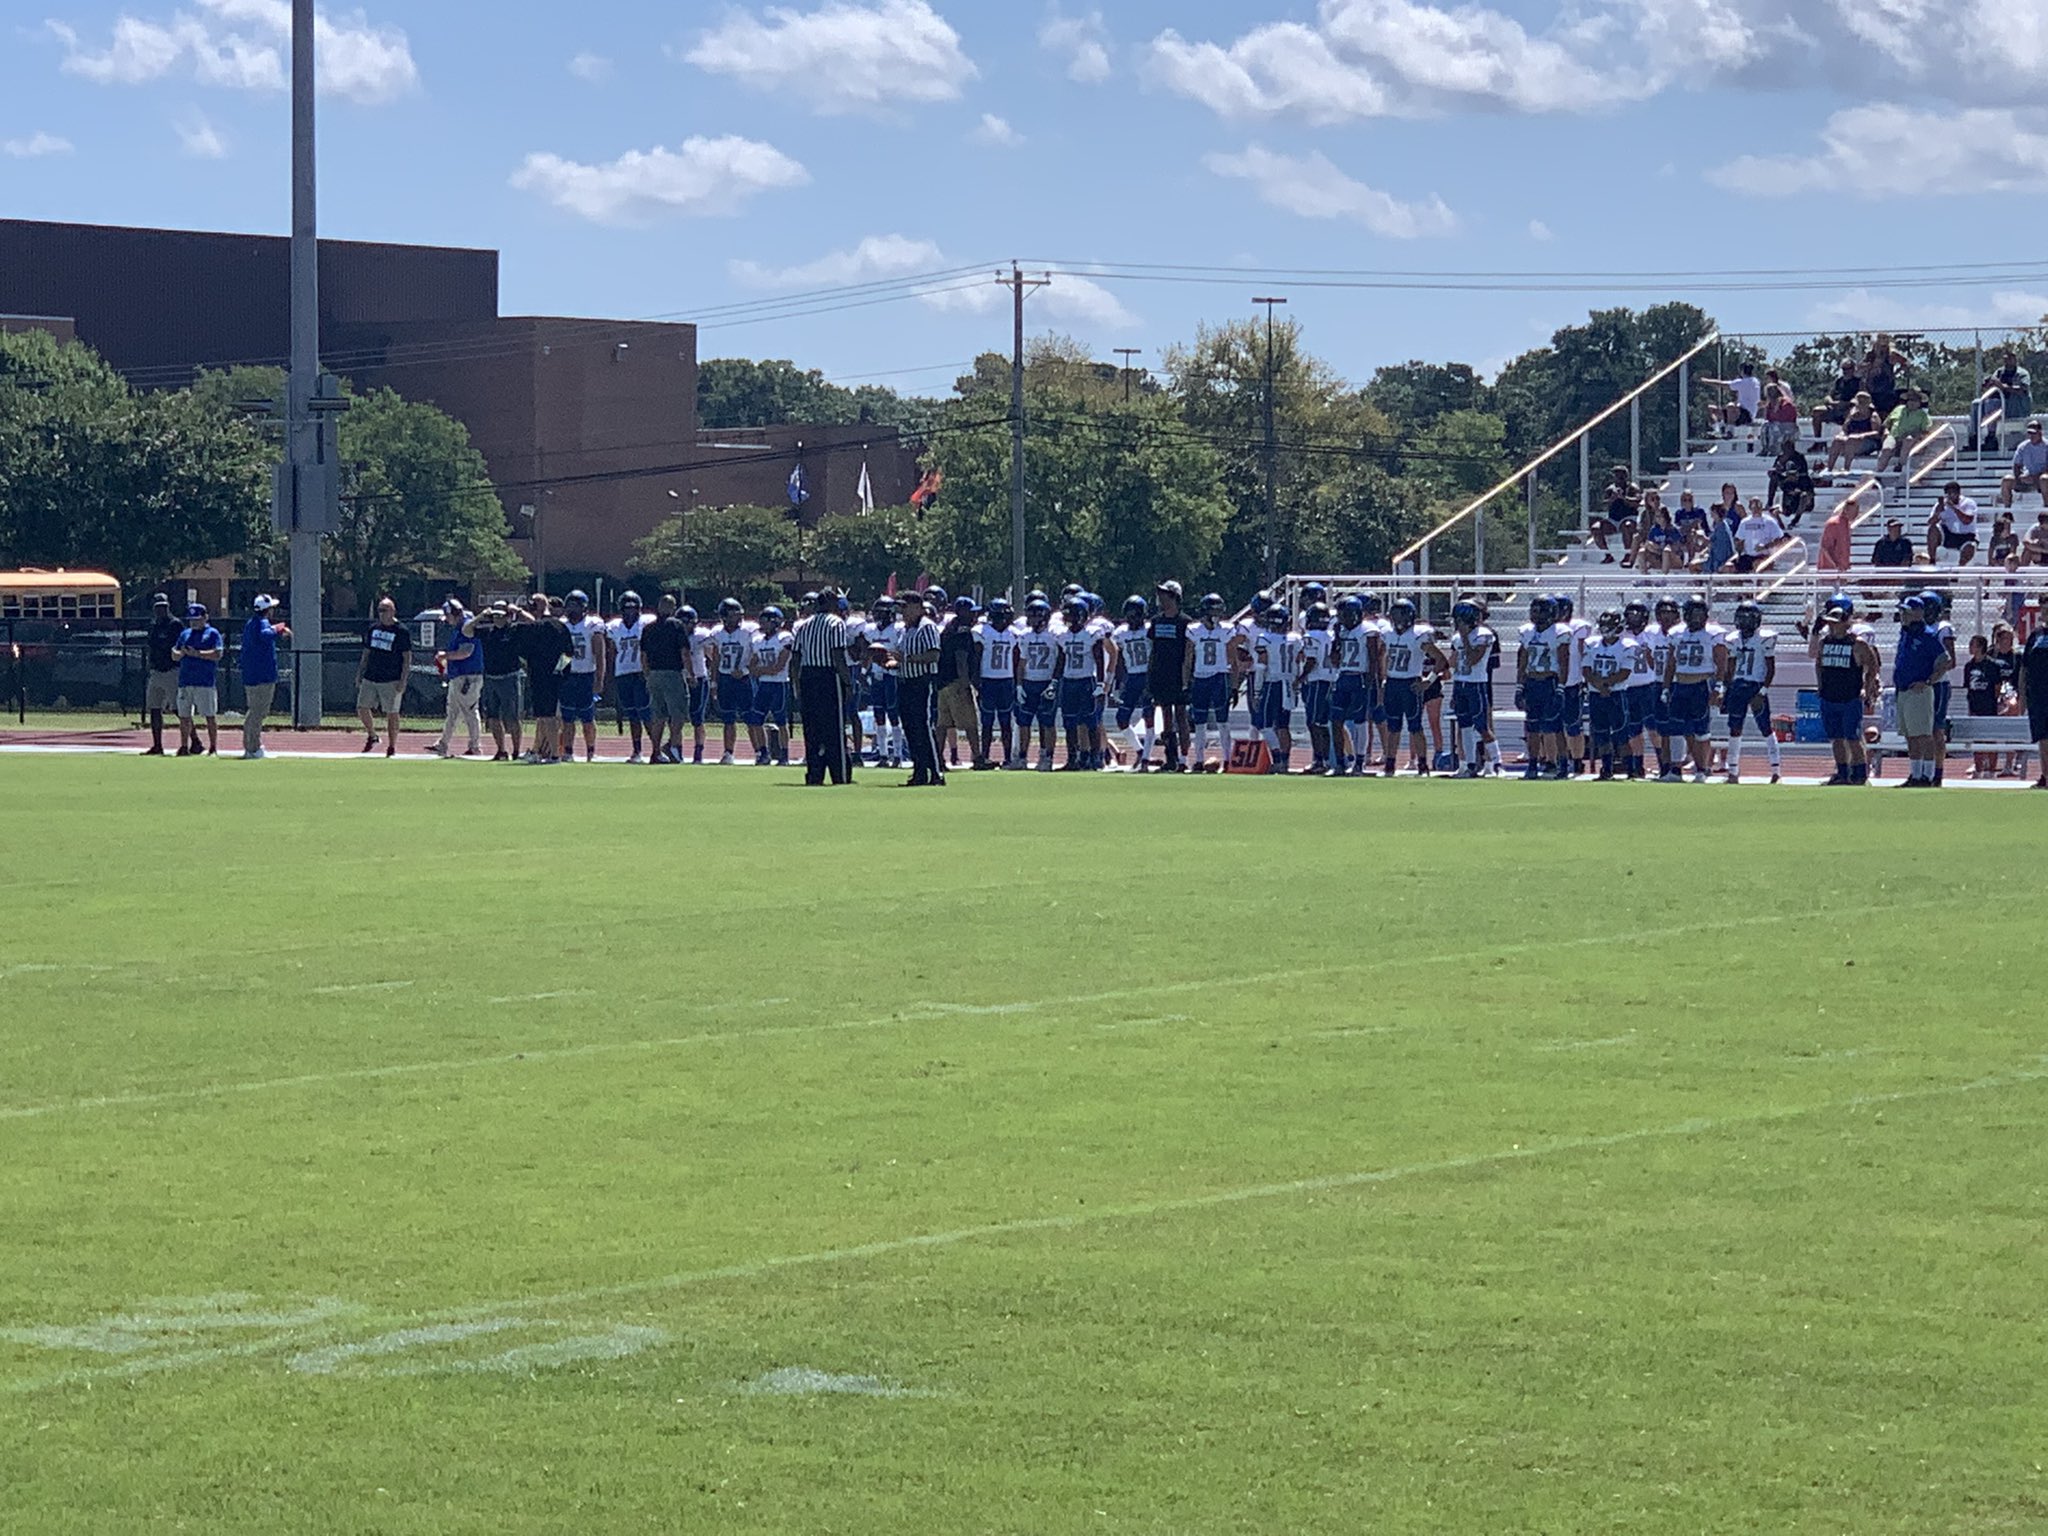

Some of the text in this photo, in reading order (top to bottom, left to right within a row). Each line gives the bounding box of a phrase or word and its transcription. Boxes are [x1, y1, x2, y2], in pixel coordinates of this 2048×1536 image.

[616, 640, 640, 664] 77
[720, 646, 744, 670] 57
[1203, 642, 1216, 666] 8
[1231, 740, 1261, 768] 50
